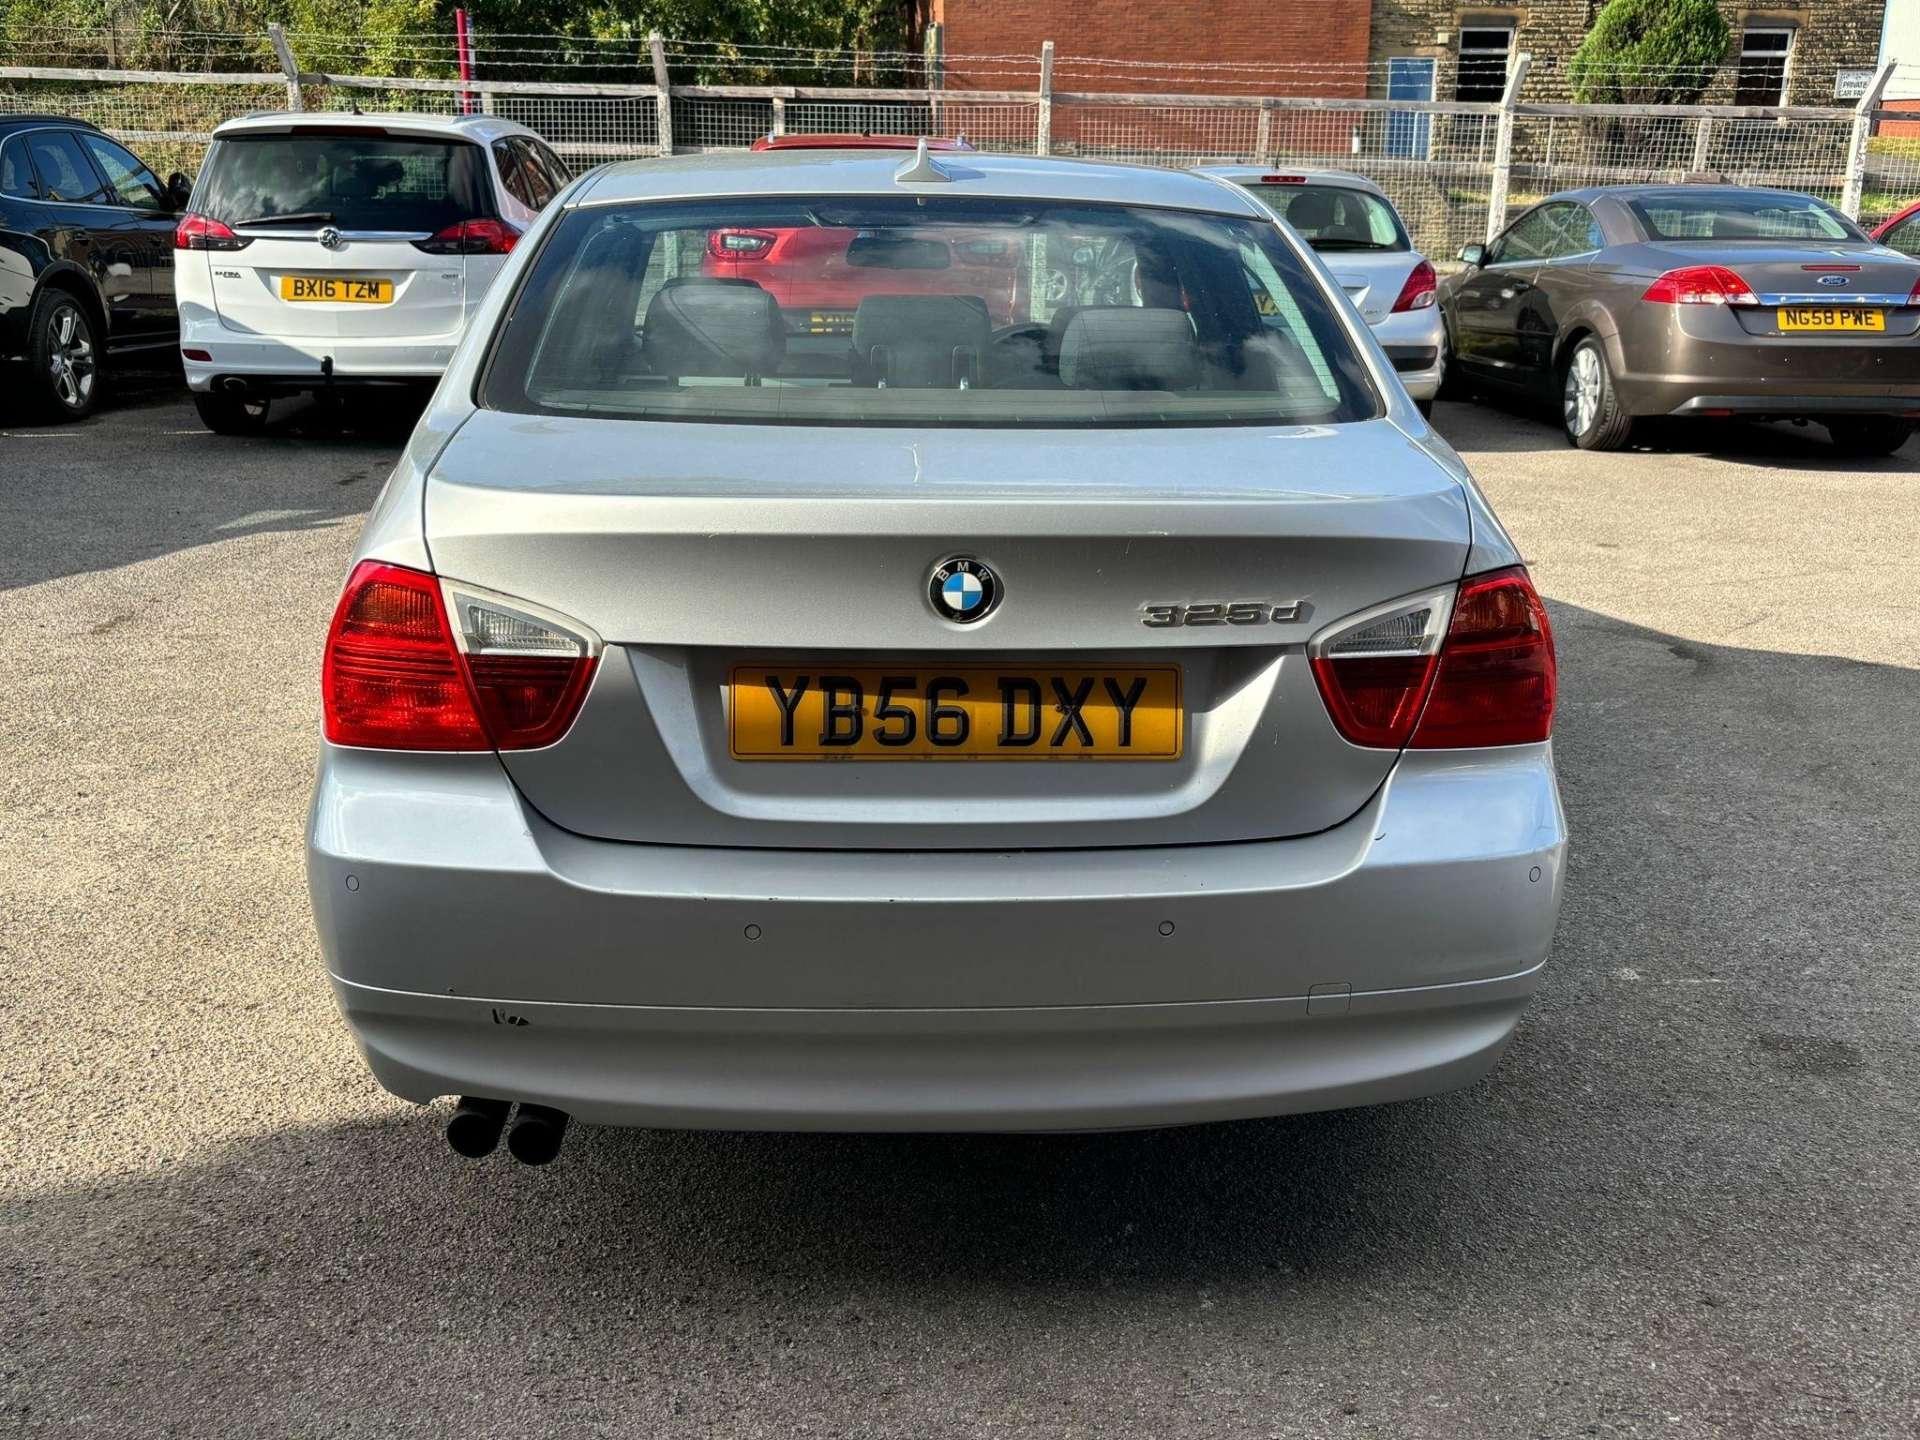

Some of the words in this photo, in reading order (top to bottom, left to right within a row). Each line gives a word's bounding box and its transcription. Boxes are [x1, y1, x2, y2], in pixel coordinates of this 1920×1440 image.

[293, 279, 336, 298] BX16
[342, 280, 380, 299] TZM
[1784, 309, 1835, 326] NG58
[1839, 310, 1876, 327] PWE
[936, 561, 990, 582] BMW
[1141, 600, 1304, 628] 325d
[765, 675, 970, 747] YB56
[996, 676, 1148, 748] DXY
